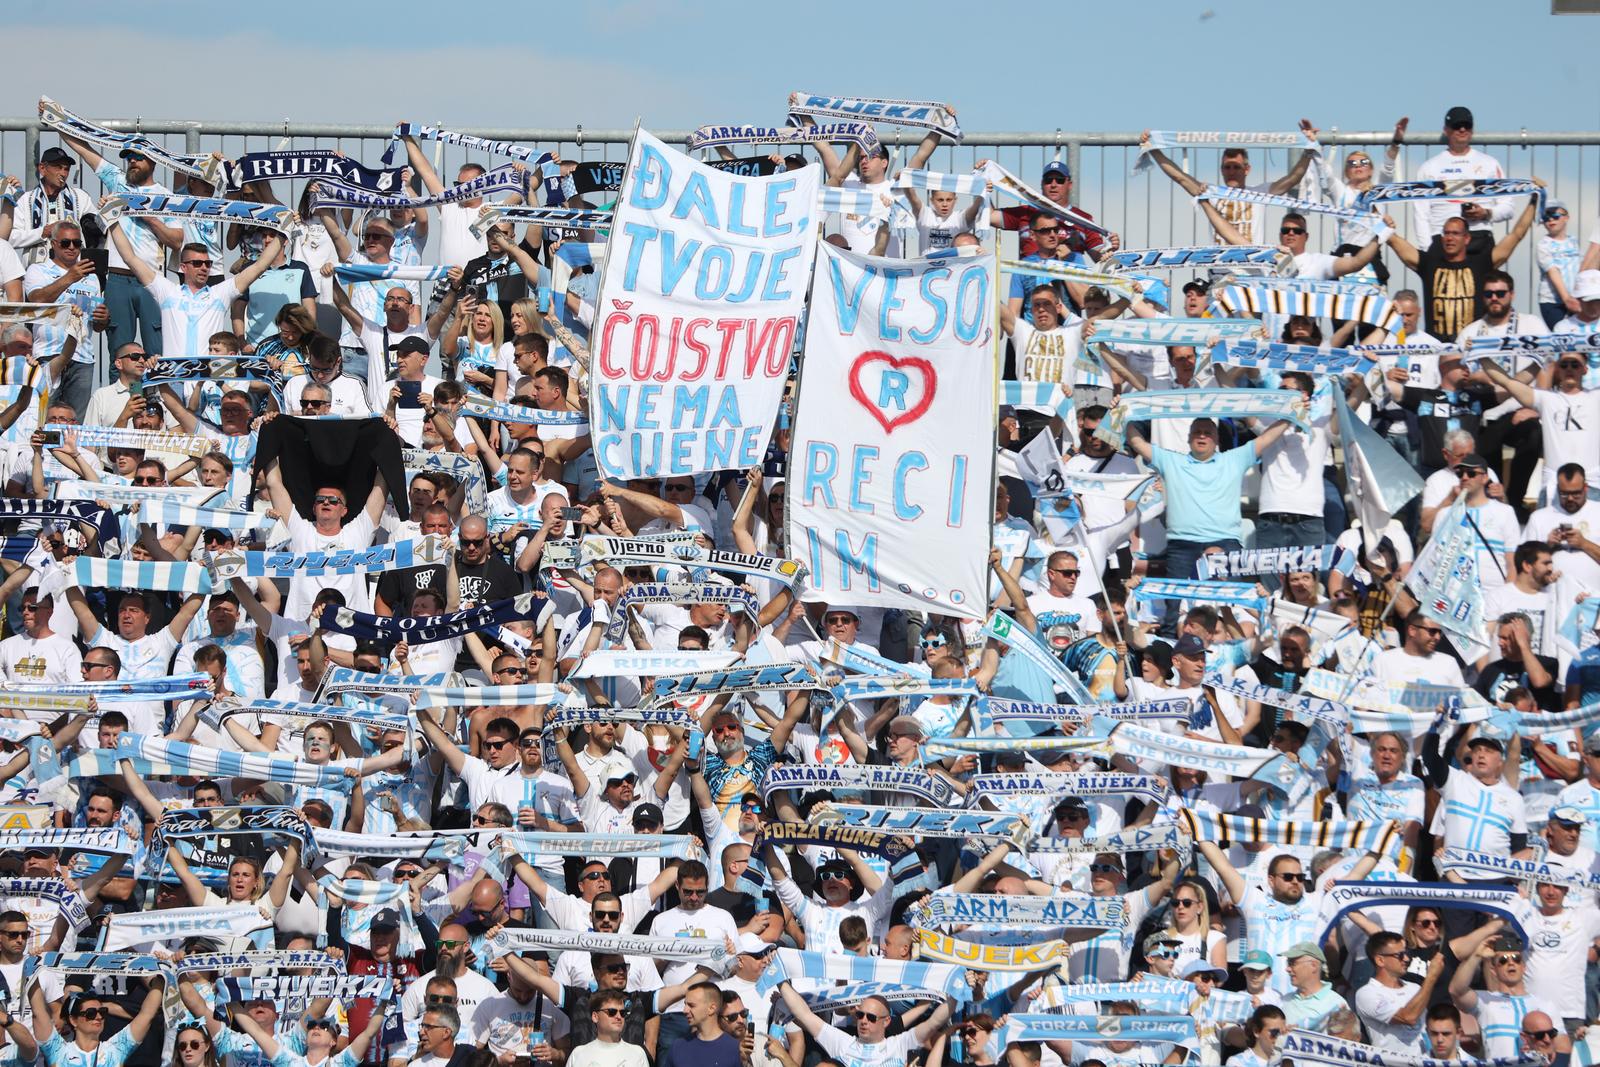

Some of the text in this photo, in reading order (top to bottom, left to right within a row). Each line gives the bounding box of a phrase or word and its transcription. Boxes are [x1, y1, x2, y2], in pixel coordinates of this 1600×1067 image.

[805, 96, 931, 120] RIJEKA
[711, 123, 864, 140] ARMADA RIJEKA
[1176, 132, 1297, 144] HNK RIJEKA
[252, 157, 362, 184] RIJEKA
[630, 143, 809, 239] ĐALE,
[121, 193, 289, 224] RIJEKA
[503, 208, 613, 224] RIJE
[623, 221, 802, 303] TVOJE
[1114, 248, 1279, 269] RIJEKA
[600, 299, 798, 382] ČOJSTVO
[879, 370, 910, 410] R
[600, 384, 742, 432] NEMA
[600, 426, 763, 476] CIJENE
[803, 440, 969, 528] RECI
[4, 500, 106, 526] IJEKA
[606, 538, 665, 555] Vjerno
[263, 548, 396, 570] RIJEKA
[1207, 545, 1324, 577] RIJEKA
[375, 604, 494, 630] FORZA
[614, 657, 700, 670] RIJEKA
[331, 667, 447, 687] RIJEKA
[654, 667, 817, 697] RIJEKA
[249, 698, 408, 723] RIJEKA
[1010, 702, 1171, 715] ARMADA RIJEKA
[1122, 727, 1205, 754] KREPAT
[1213, 747, 1249, 759] MA
[1128, 743, 1156, 758] NE
[1162, 750, 1241, 773] MOLAT
[771, 768, 933, 791] ARMADA RIJEKA
[1078, 777, 1147, 788] RIJEKA
[838, 807, 1020, 836] RIJEKA
[31, 828, 121, 849] RIJEKA
[540, 838, 662, 852] HNK RIJEKA
[764, 822, 887, 848] FORZA FIUME
[206, 854, 228, 864] SAVA
[1466, 852, 1551, 875] ARMADA
[1518, 871, 1553, 882] FORZA
[11, 880, 76, 906] RIJEKA
[1332, 886, 1386, 905] FORZA
[1461, 888, 1515, 905] FIUME
[952, 898, 1098, 919] ARM ADA
[140, 919, 232, 936] RIJEKA
[516, 933, 552, 945] nema
[558, 933, 613, 949] zakona
[657, 940, 676, 952] od
[678, 944, 706, 956] nas
[920, 929, 1066, 966] RIJEKA
[177, 955, 249, 969] RMADA
[252, 976, 388, 999] RIJEKA
[1067, 980, 1190, 997] HNK RIJEKA
[1031, 1020, 1189, 1035] FORZA RIJEKA
[1284, 1035, 1386, 1066] ARMADA
